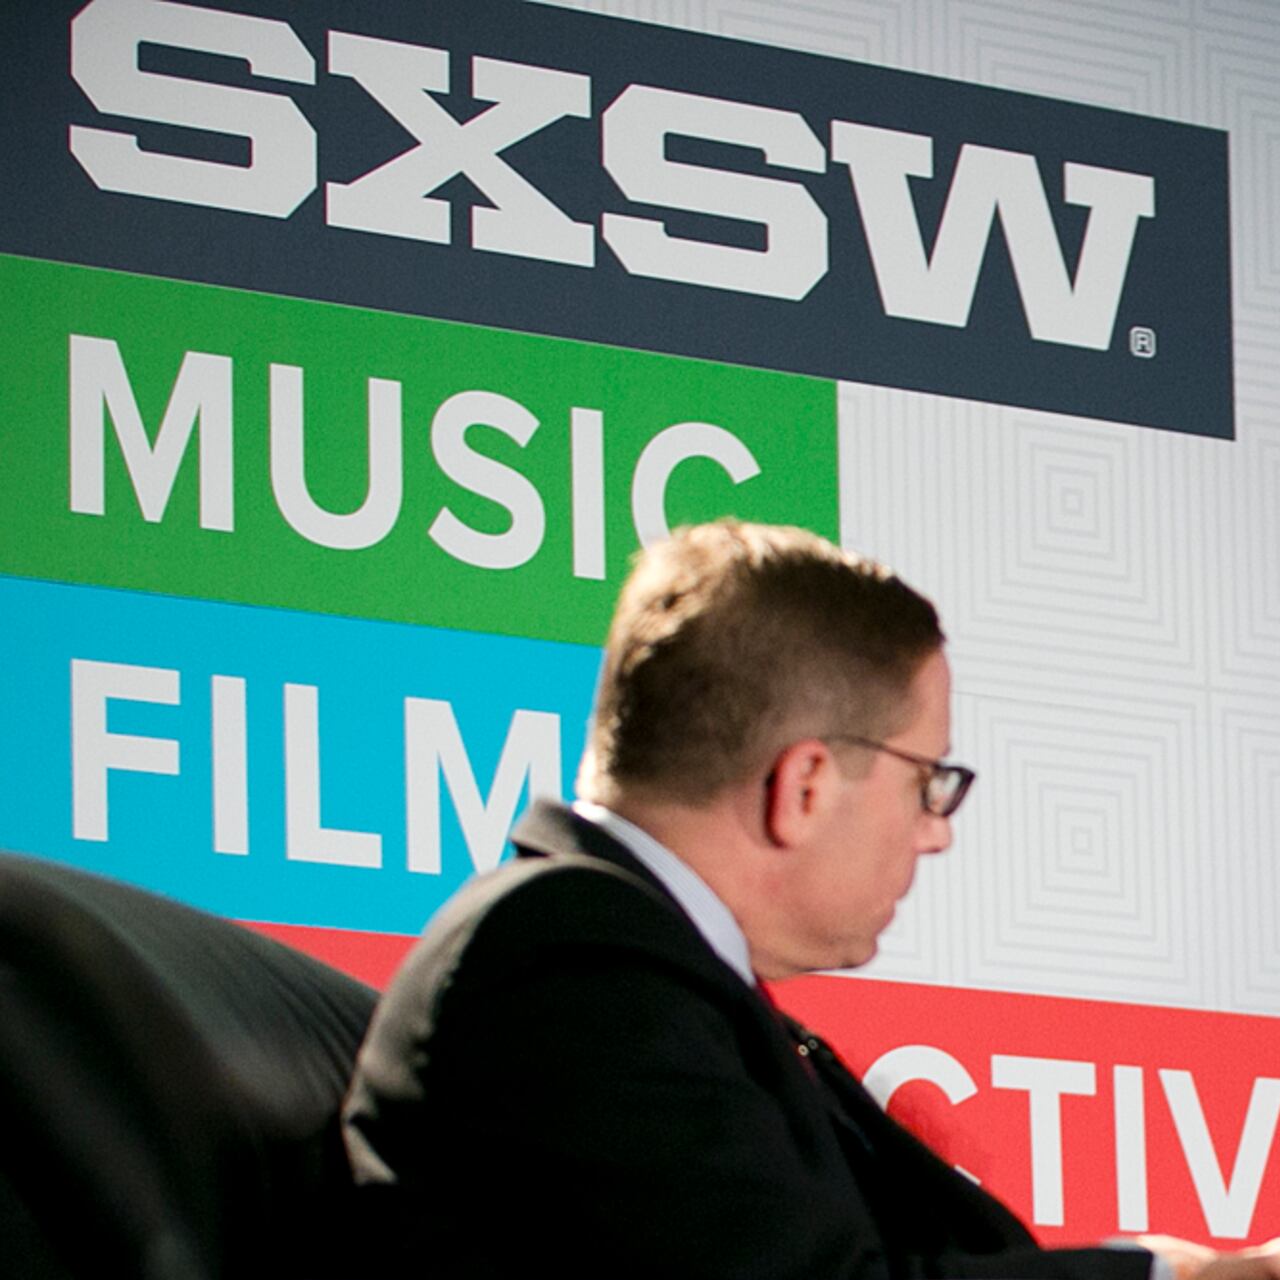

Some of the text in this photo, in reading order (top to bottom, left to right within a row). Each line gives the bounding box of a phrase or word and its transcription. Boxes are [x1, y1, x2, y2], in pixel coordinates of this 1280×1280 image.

[69, 0, 1155, 351] SXSW
[68, 334, 762, 581] MUSIC
[71, 658, 563, 875] FILM
